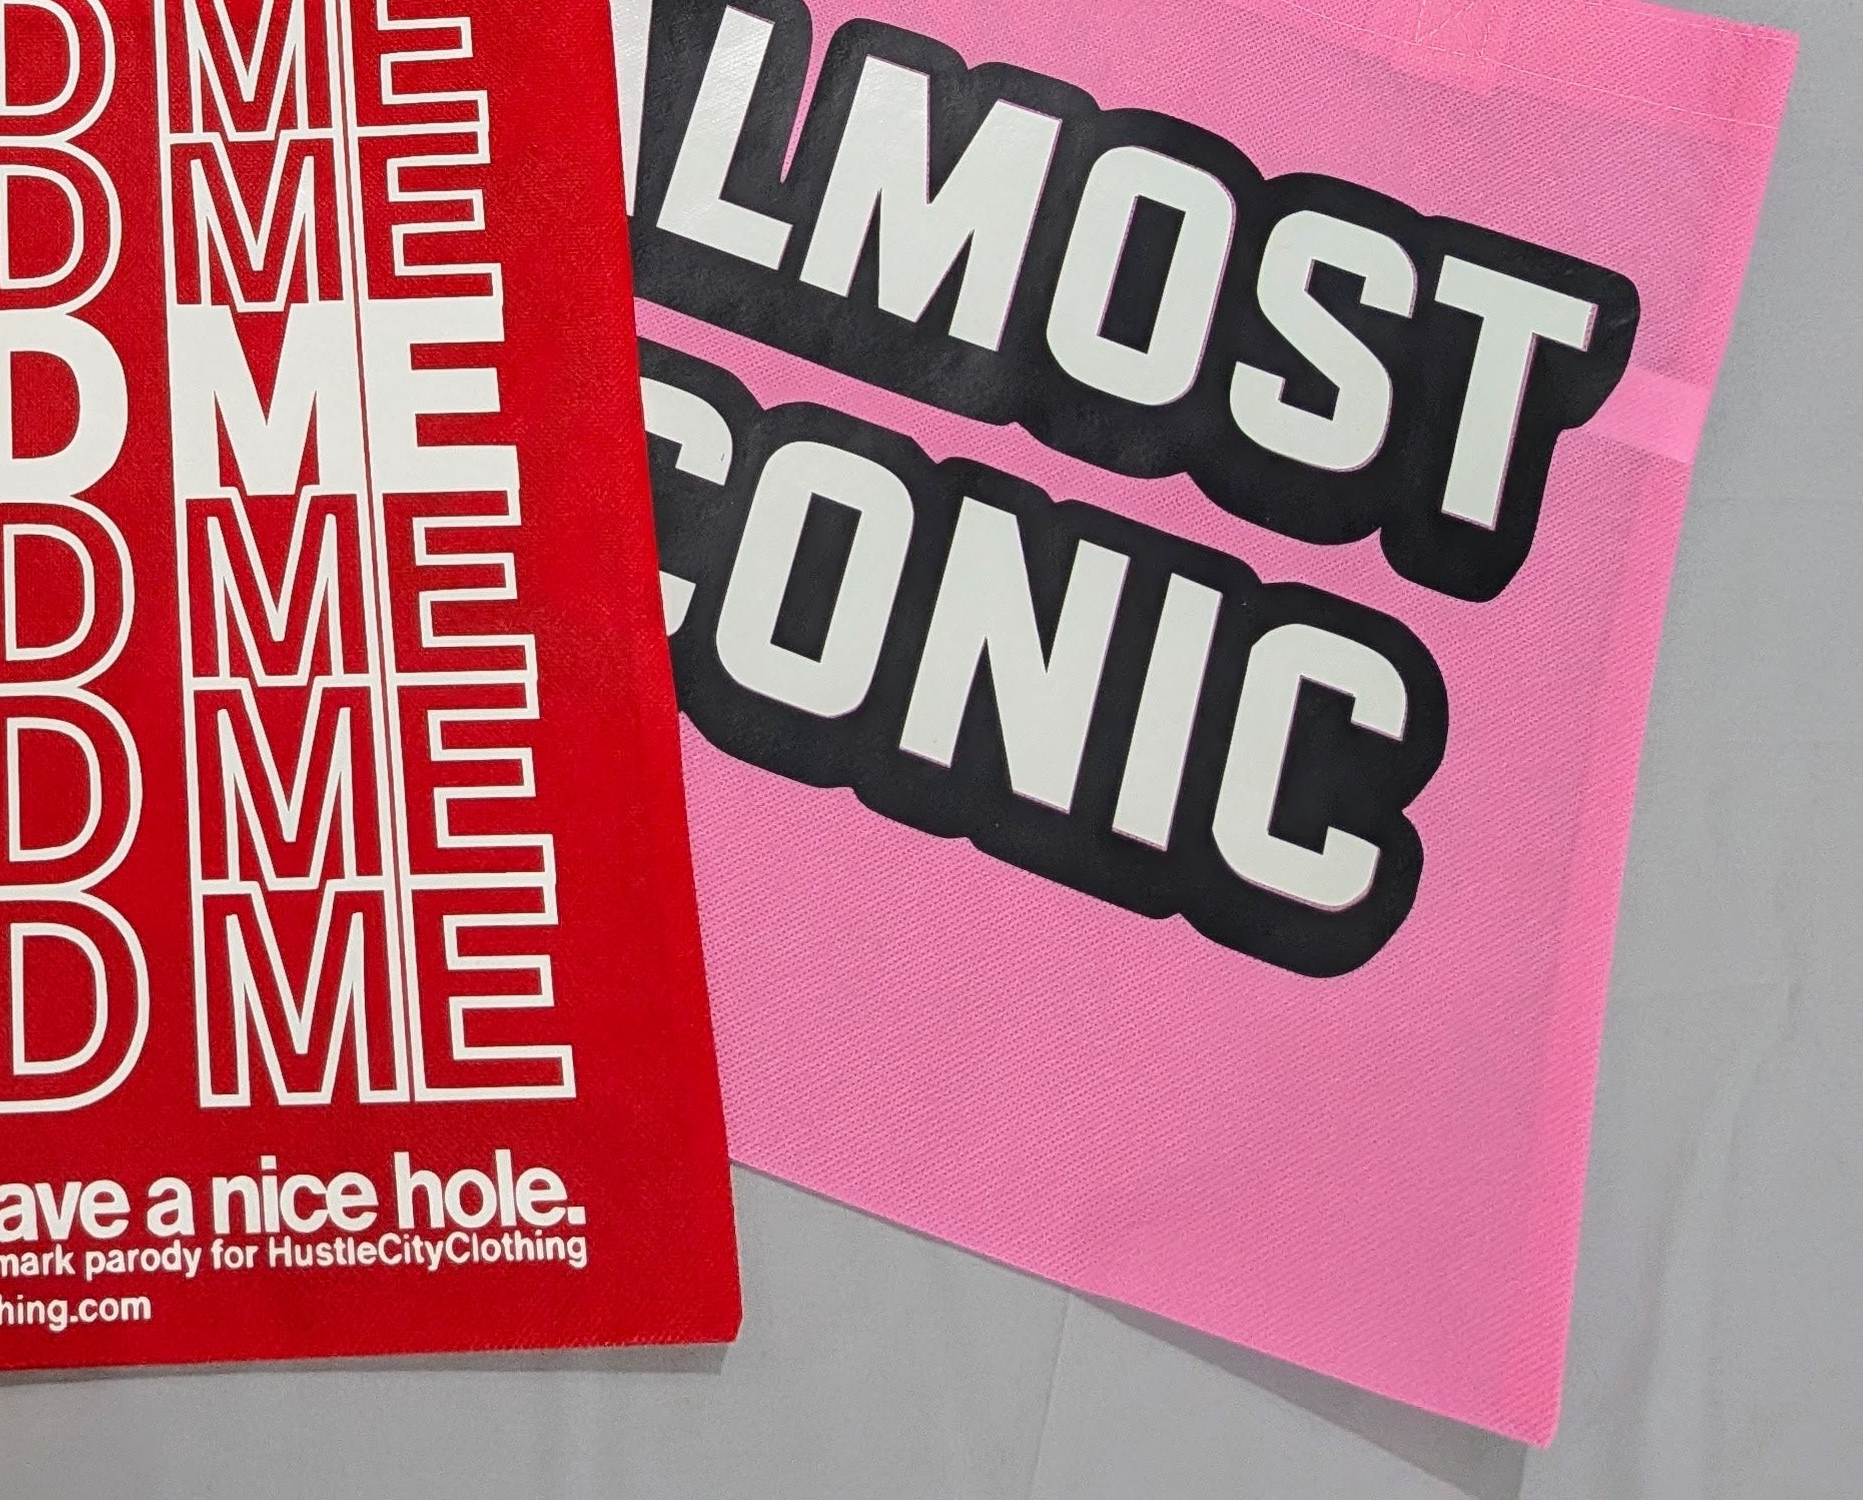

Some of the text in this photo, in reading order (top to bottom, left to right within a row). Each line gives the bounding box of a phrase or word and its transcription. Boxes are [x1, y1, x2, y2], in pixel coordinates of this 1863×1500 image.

[162, 123, 504, 312] ME
[169, 297, 521, 500] ME
[176, 489, 540, 690] ME
[187, 679, 558, 898] ME
[198, 879, 577, 1108] ME
[84, 1241, 203, 1283] parody
[211, 1238, 258, 1270] for
[268, 1230, 588, 1273] HustleCityClothing
[146, 1176, 195, 1238] a
[213, 1155, 379, 1235] nice
[393, 1148, 587, 1230] hole.
